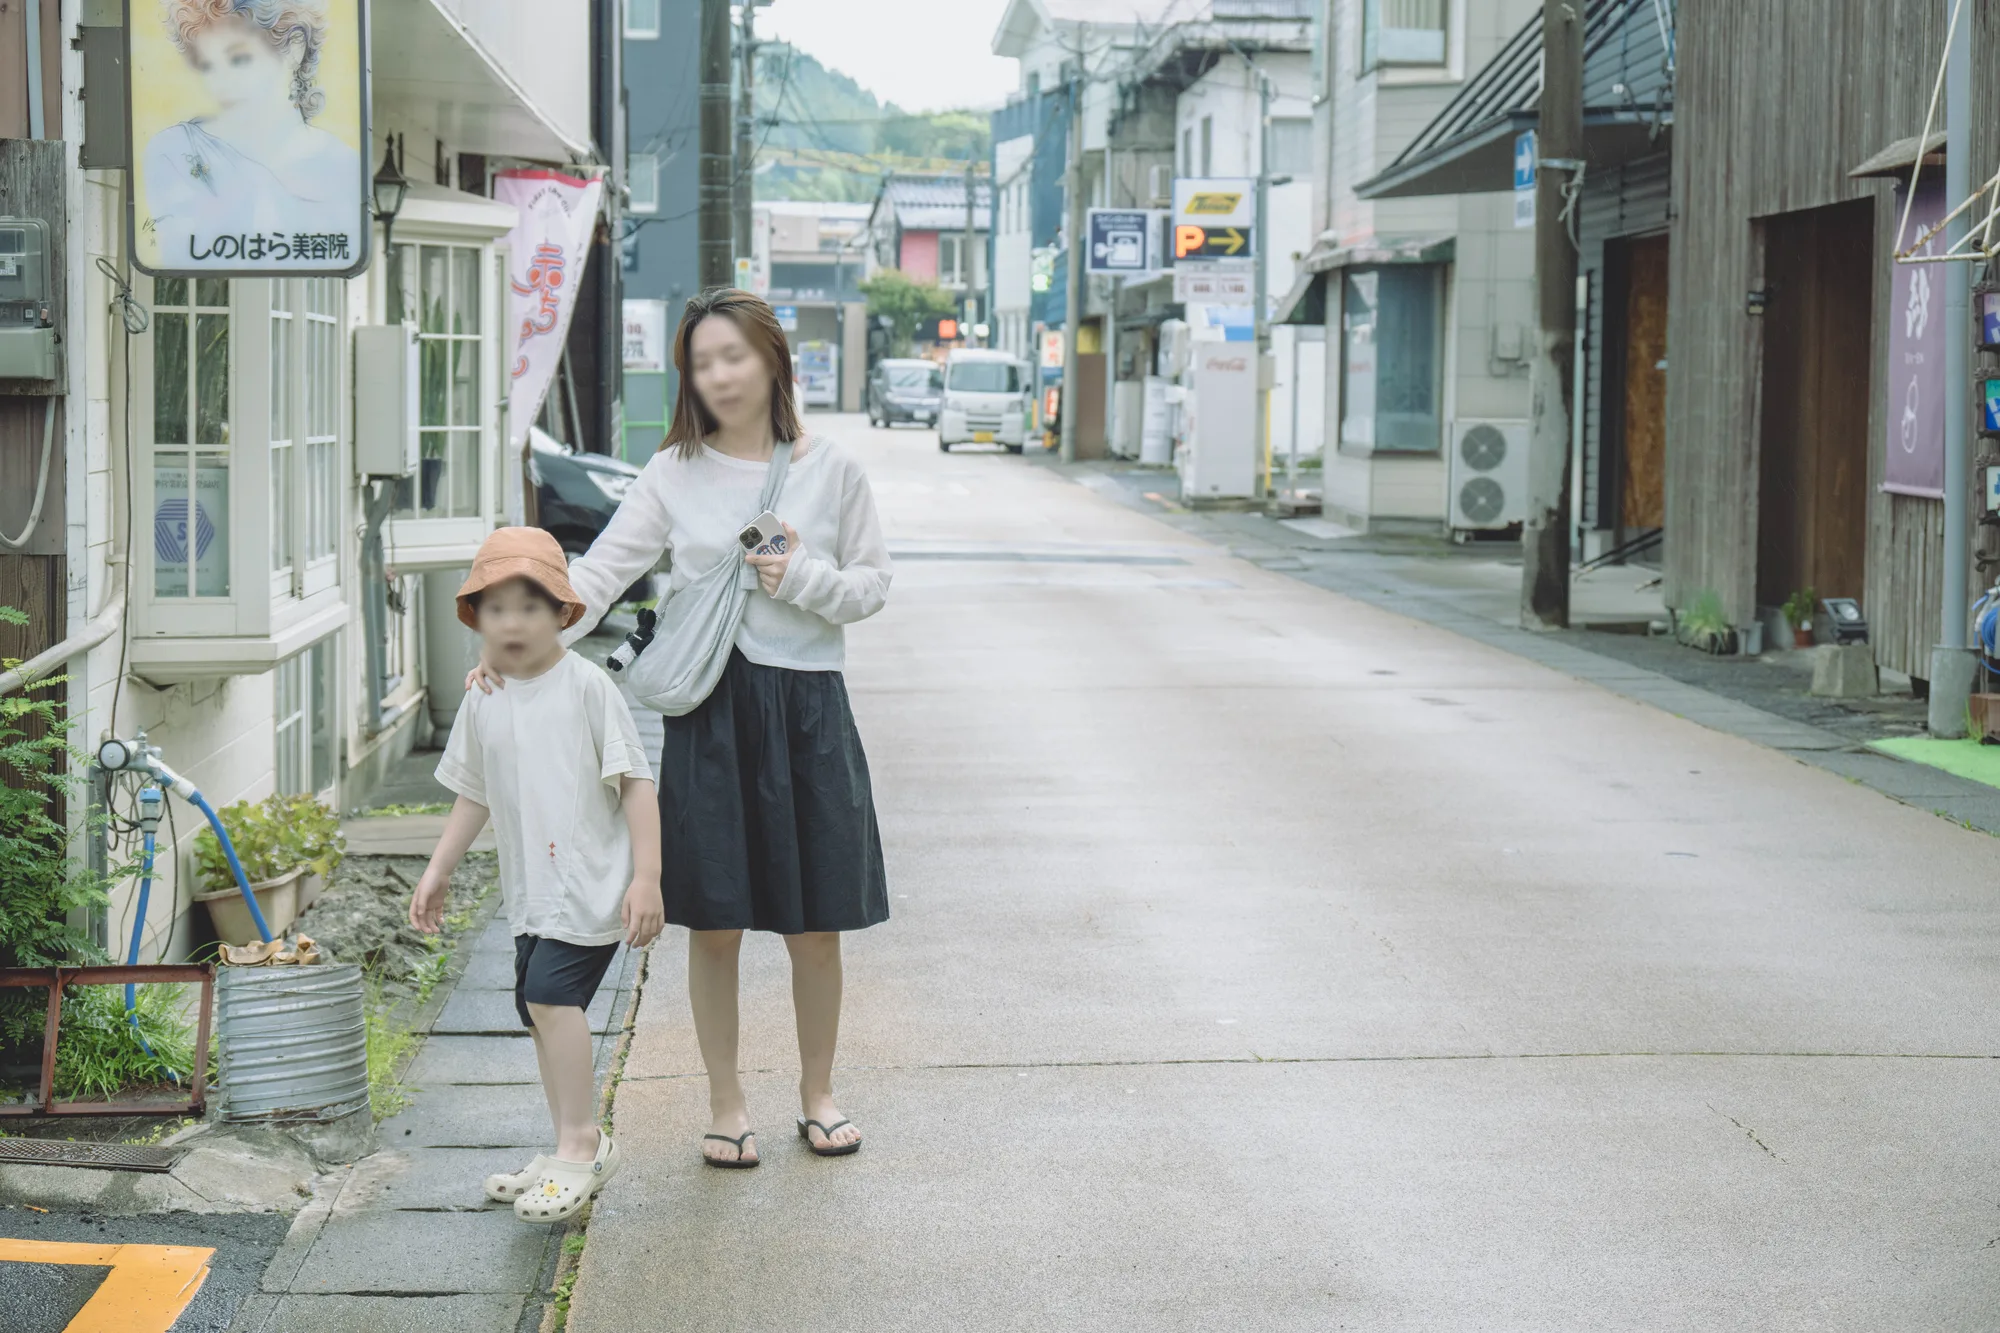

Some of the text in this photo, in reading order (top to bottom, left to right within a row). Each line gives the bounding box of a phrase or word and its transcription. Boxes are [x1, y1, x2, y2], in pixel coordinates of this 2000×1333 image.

[189, 231, 349, 261] しのはら美容院
[1176, 225, 1205, 259] P
